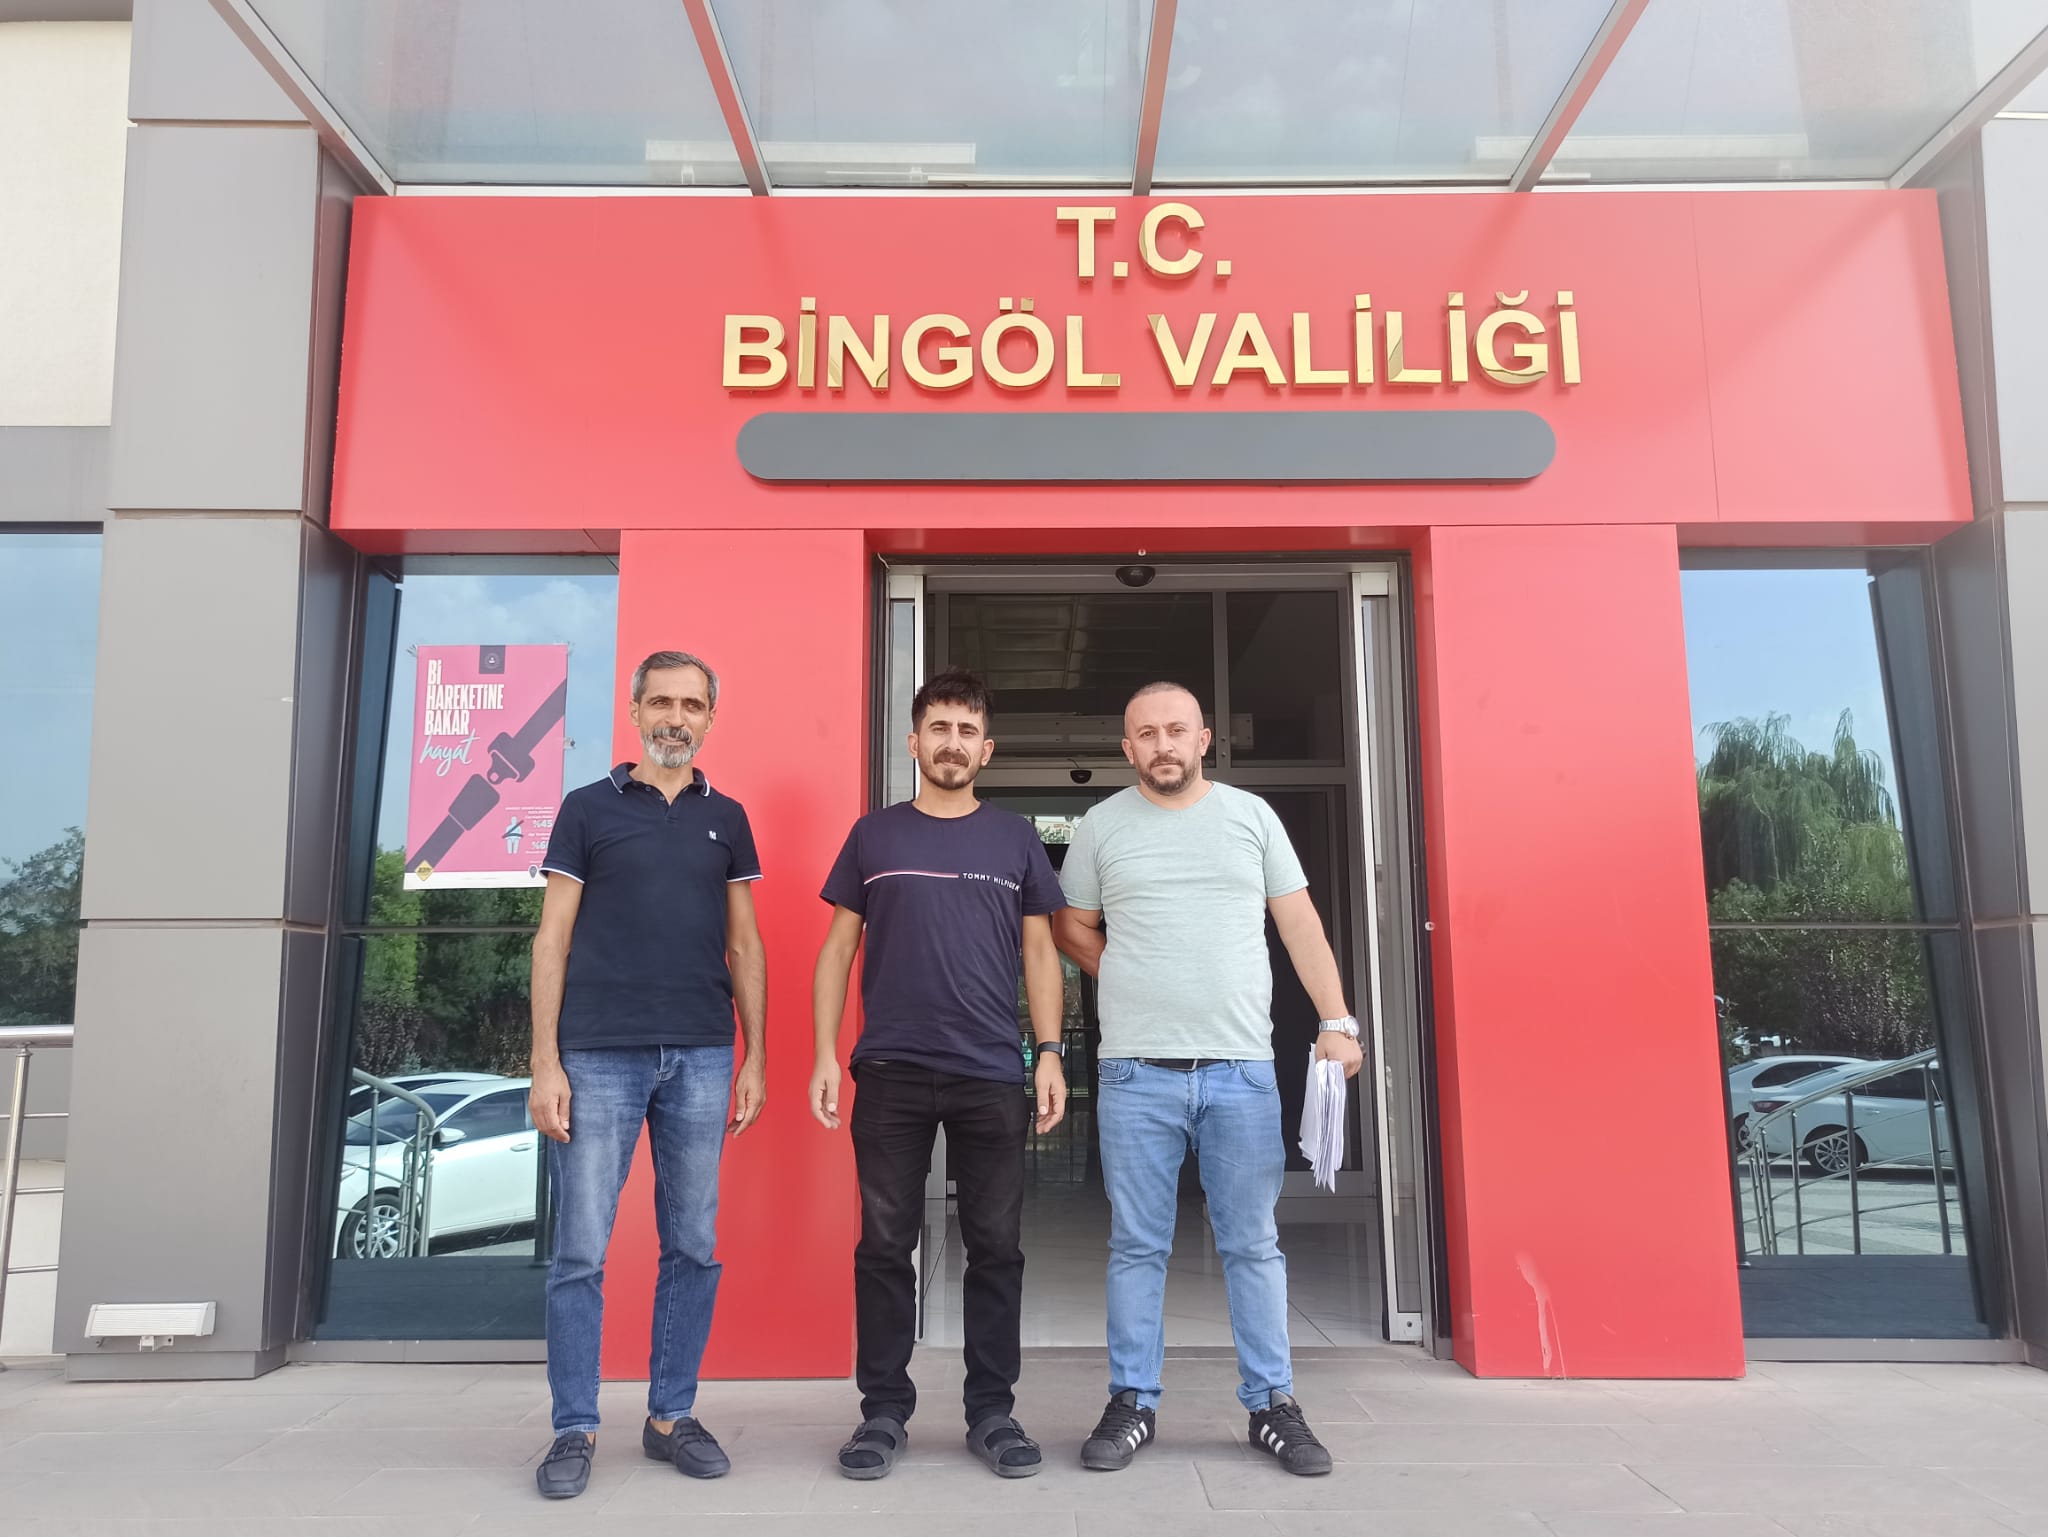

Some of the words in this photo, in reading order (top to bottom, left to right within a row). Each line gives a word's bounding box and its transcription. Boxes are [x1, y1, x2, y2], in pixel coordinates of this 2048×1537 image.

[1056, 202, 1232, 279] T.C.
[722, 296, 1121, 391] BİNGÖL
[1147, 289, 1582, 390] VALİLİĞİ
[424, 709, 470, 736] BAKAR
[419, 728, 481, 777] hayat
[962, 872, 991, 881] TOMMY
